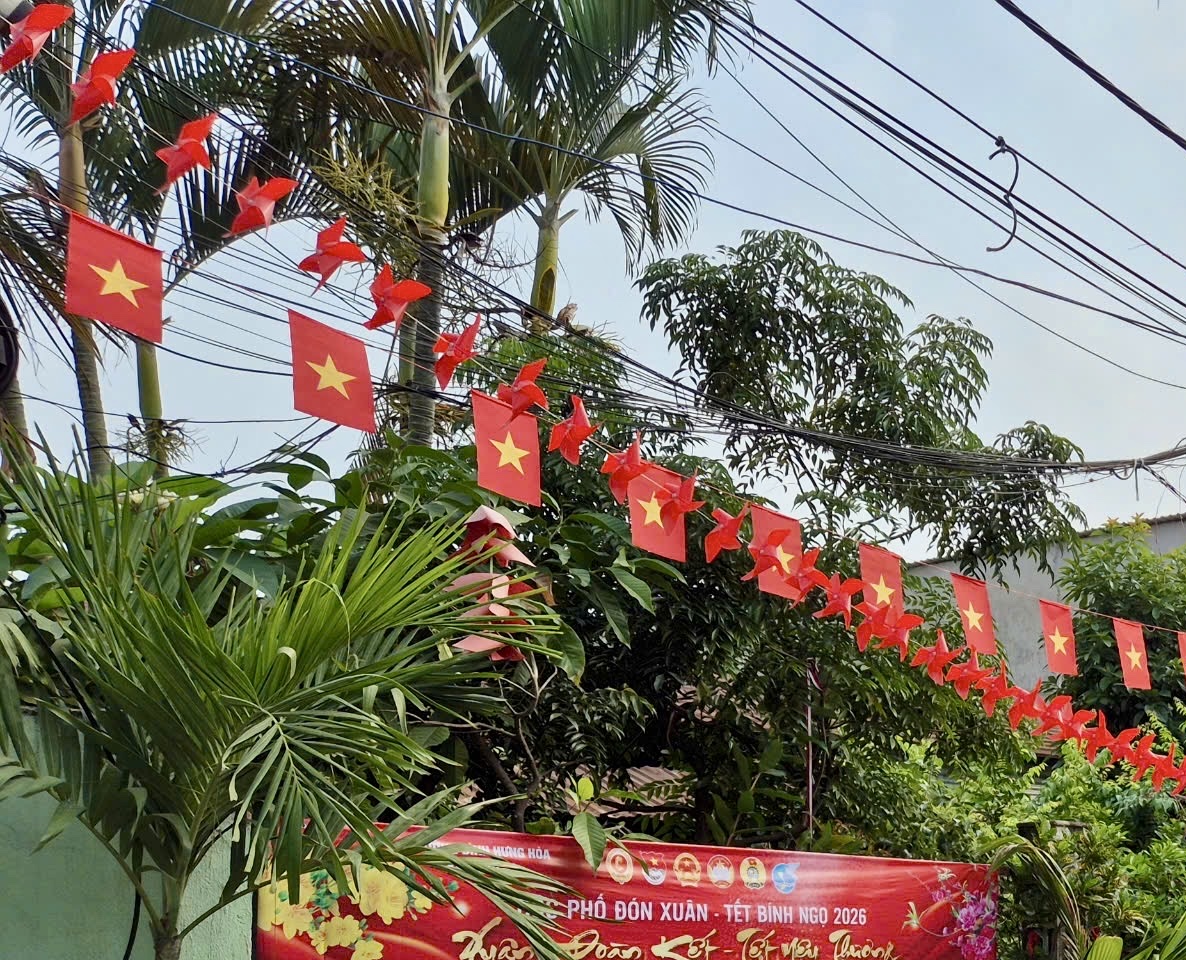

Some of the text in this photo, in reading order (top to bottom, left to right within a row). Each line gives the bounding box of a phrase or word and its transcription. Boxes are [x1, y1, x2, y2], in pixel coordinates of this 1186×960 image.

[493, 846, 525, 858] HƯNG
[528, 846, 550, 860] HÒA
[567, 893, 608, 920] PHỐ
[614, 897, 653, 921] ĐÓN
[660, 899, 708, 922] XUÂN
[723, 899, 752, 922] TẾT
[757, 903, 793, 923] BÍNH
[799, 906, 828, 928] NGỌ
[833, 907, 867, 926] 2026
